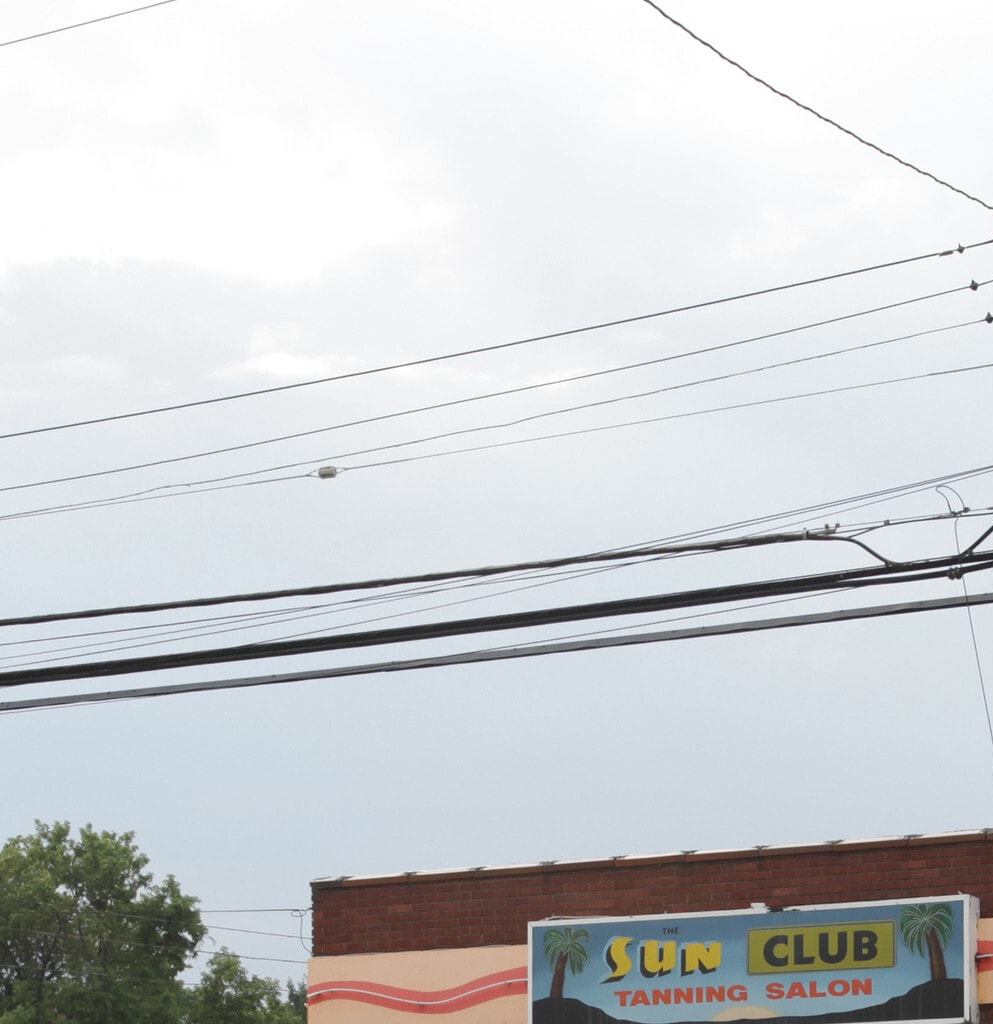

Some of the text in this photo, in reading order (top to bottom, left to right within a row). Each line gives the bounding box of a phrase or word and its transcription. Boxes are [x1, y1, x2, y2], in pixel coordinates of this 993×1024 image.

[662, 927, 679, 935] THE
[600, 930, 878, 984] SUN CLUB
[614, 978, 873, 1007] TANNING SALON
